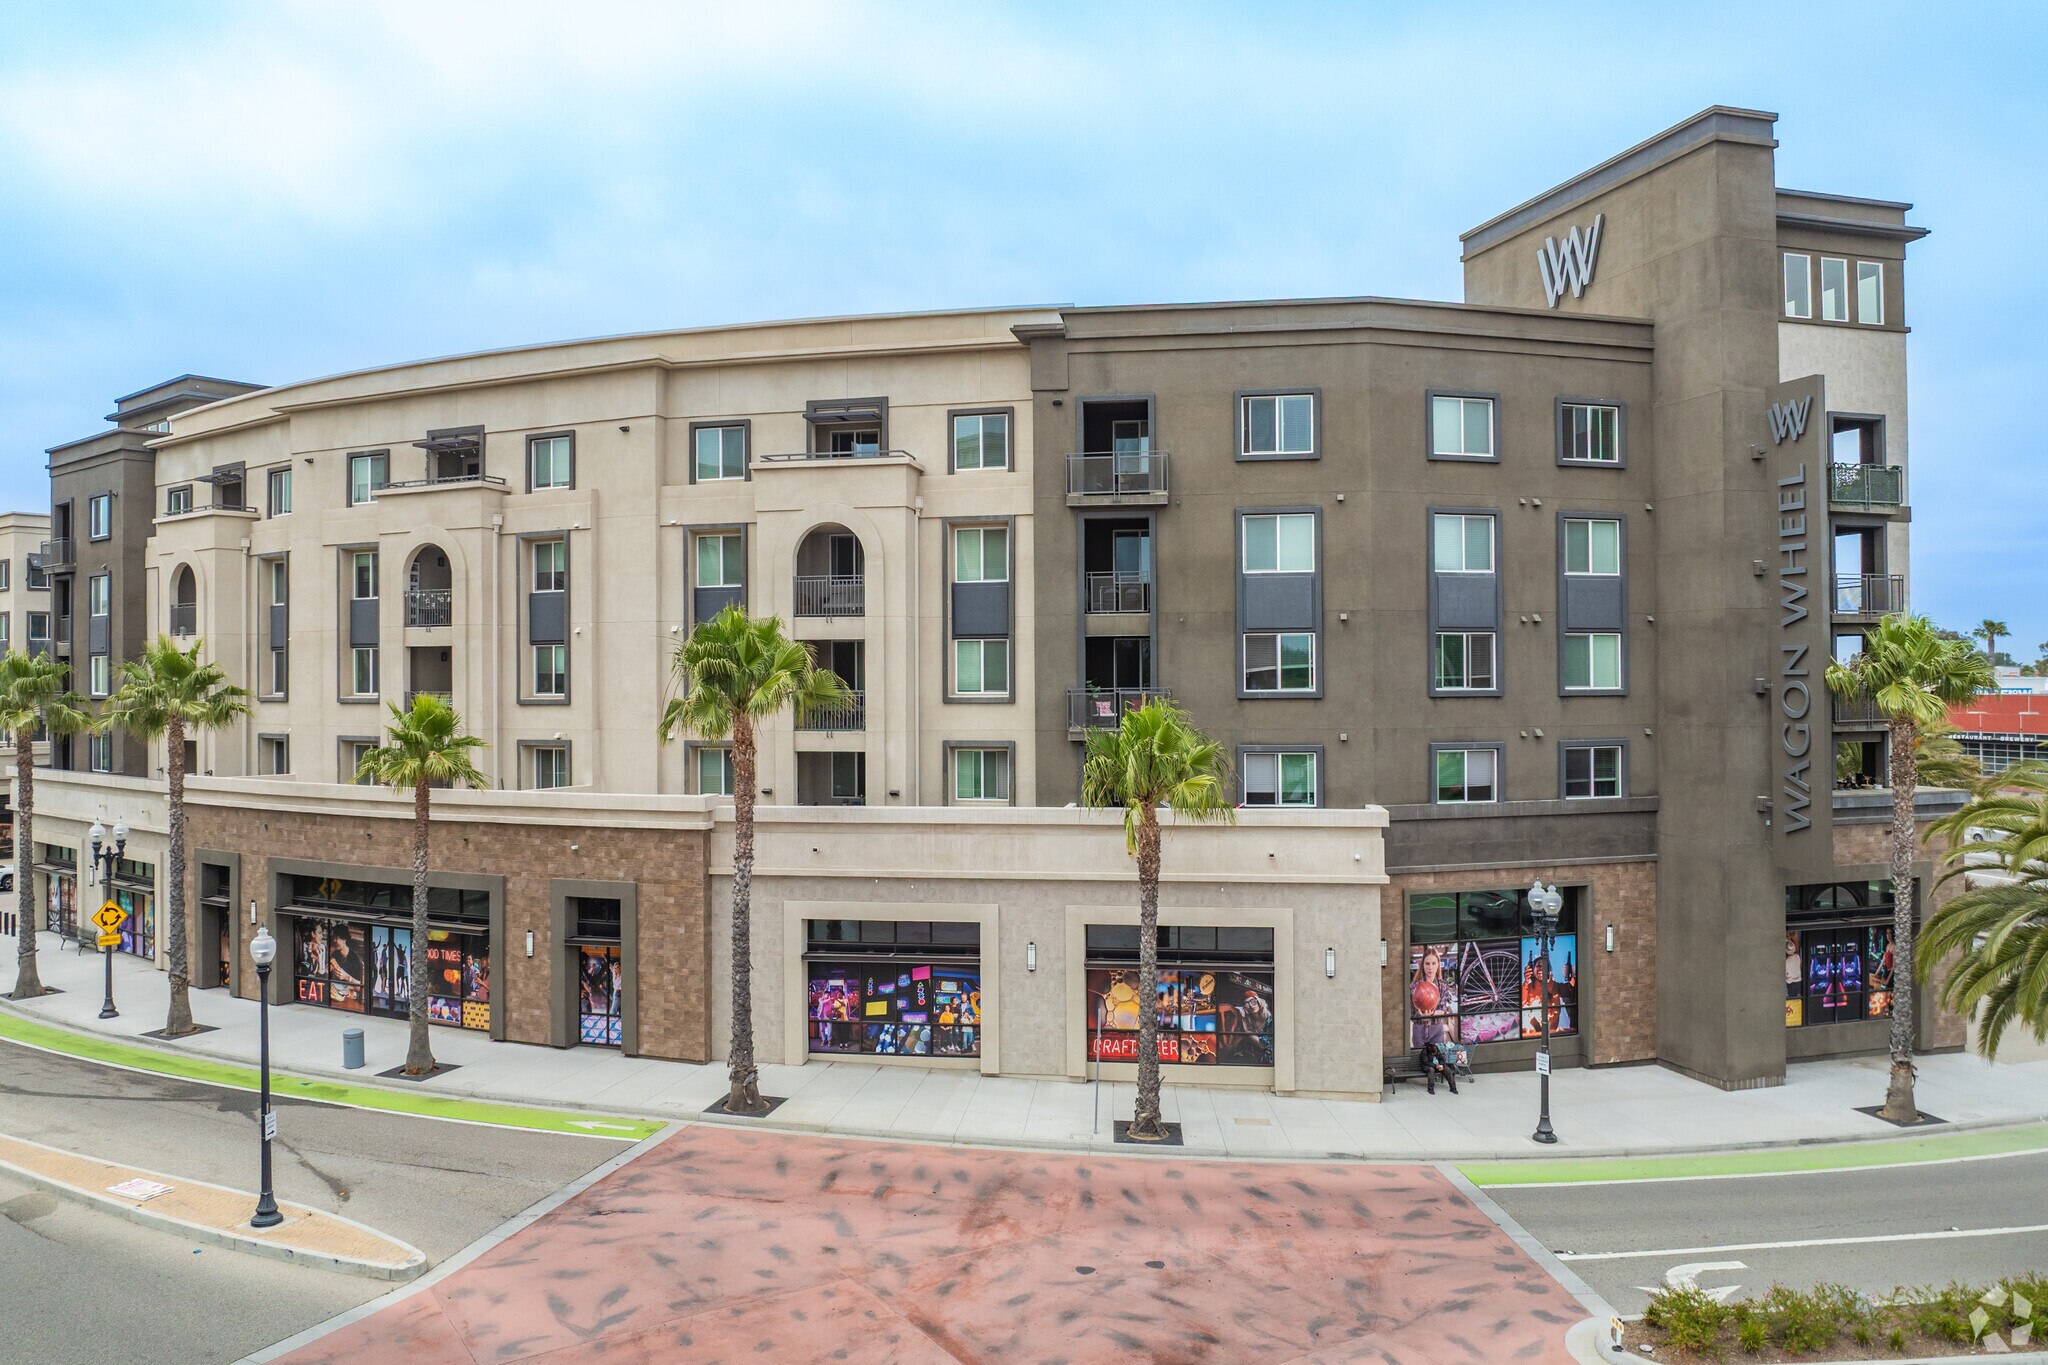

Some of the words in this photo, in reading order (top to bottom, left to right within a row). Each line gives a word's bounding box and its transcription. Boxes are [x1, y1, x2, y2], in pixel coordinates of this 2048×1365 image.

[1777, 463, 1808, 627] WHEEL
[1781, 644, 1811, 833] WAGON
[441, 949, 462, 962] TIMES
[299, 979, 326, 1002] EAT
[1093, 1039, 1137, 1055] CRAFT
[1156, 1040, 1179, 1056] ER
